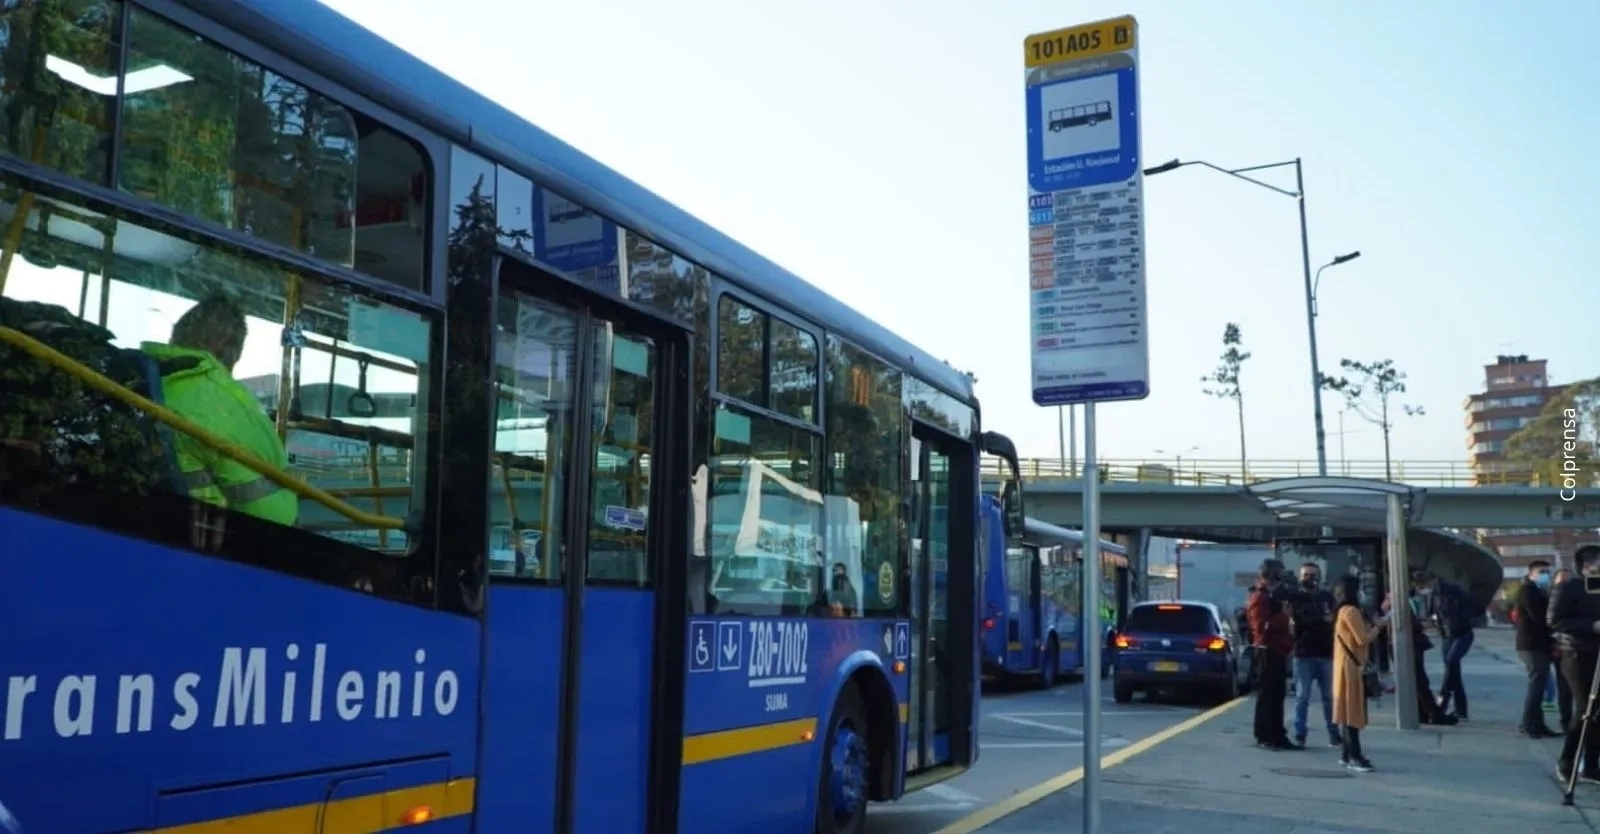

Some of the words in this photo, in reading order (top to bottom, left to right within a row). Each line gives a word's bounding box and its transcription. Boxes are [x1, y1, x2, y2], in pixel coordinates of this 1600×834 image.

[1032, 29, 1102, 60] 101A05
[749, 622, 807, 676] Z80-7002
[765, 693, 788, 711] SUMA
